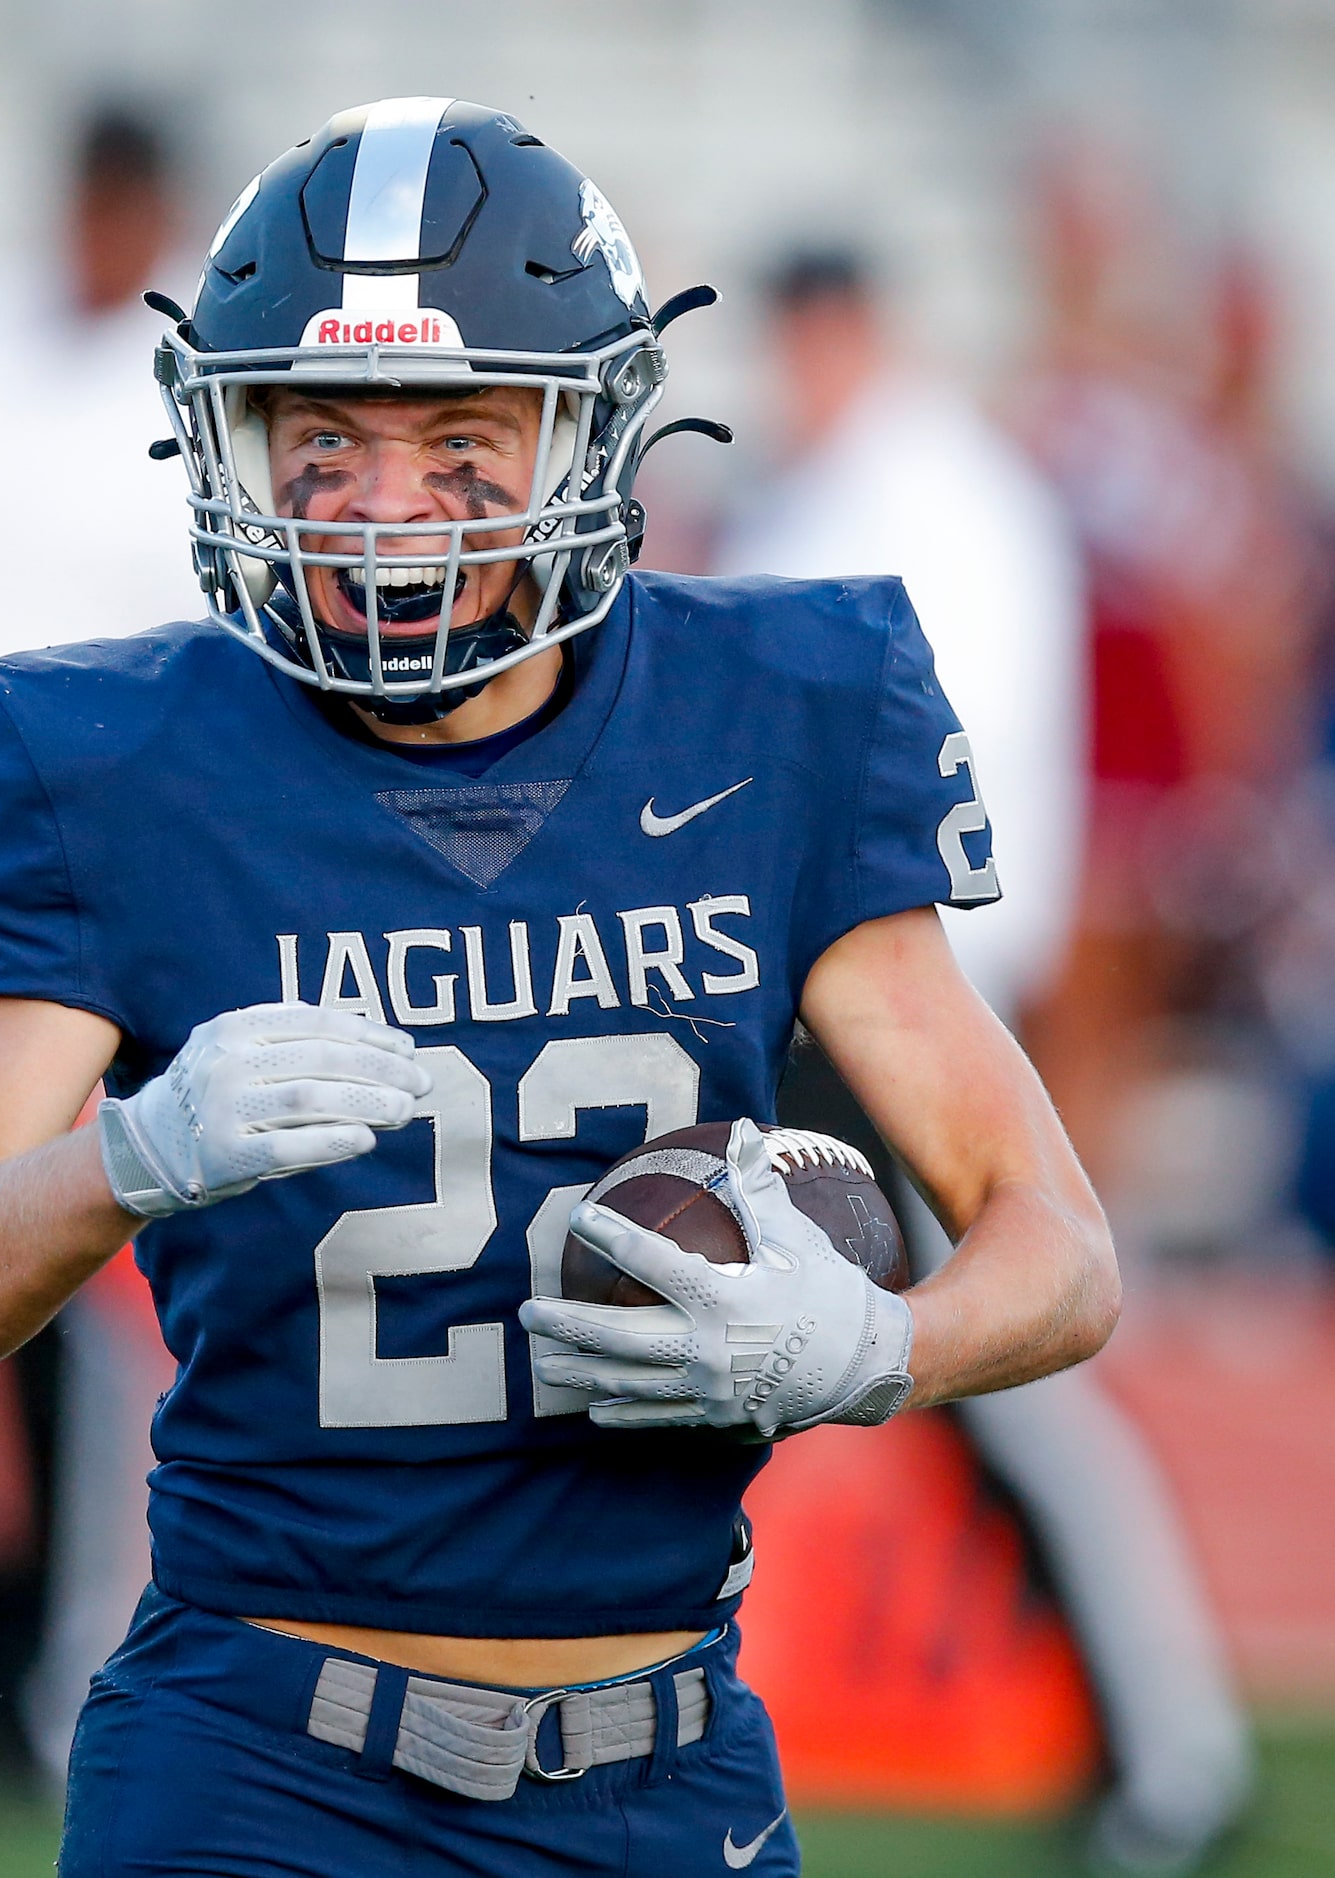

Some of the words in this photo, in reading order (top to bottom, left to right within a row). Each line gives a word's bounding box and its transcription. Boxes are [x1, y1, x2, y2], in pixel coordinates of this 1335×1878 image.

[318, 317, 440, 343] Riddell
[369, 655, 433, 671] iddell
[275, 894, 761, 1026] JAGUARS
[743, 1314, 817, 1412] adidas
